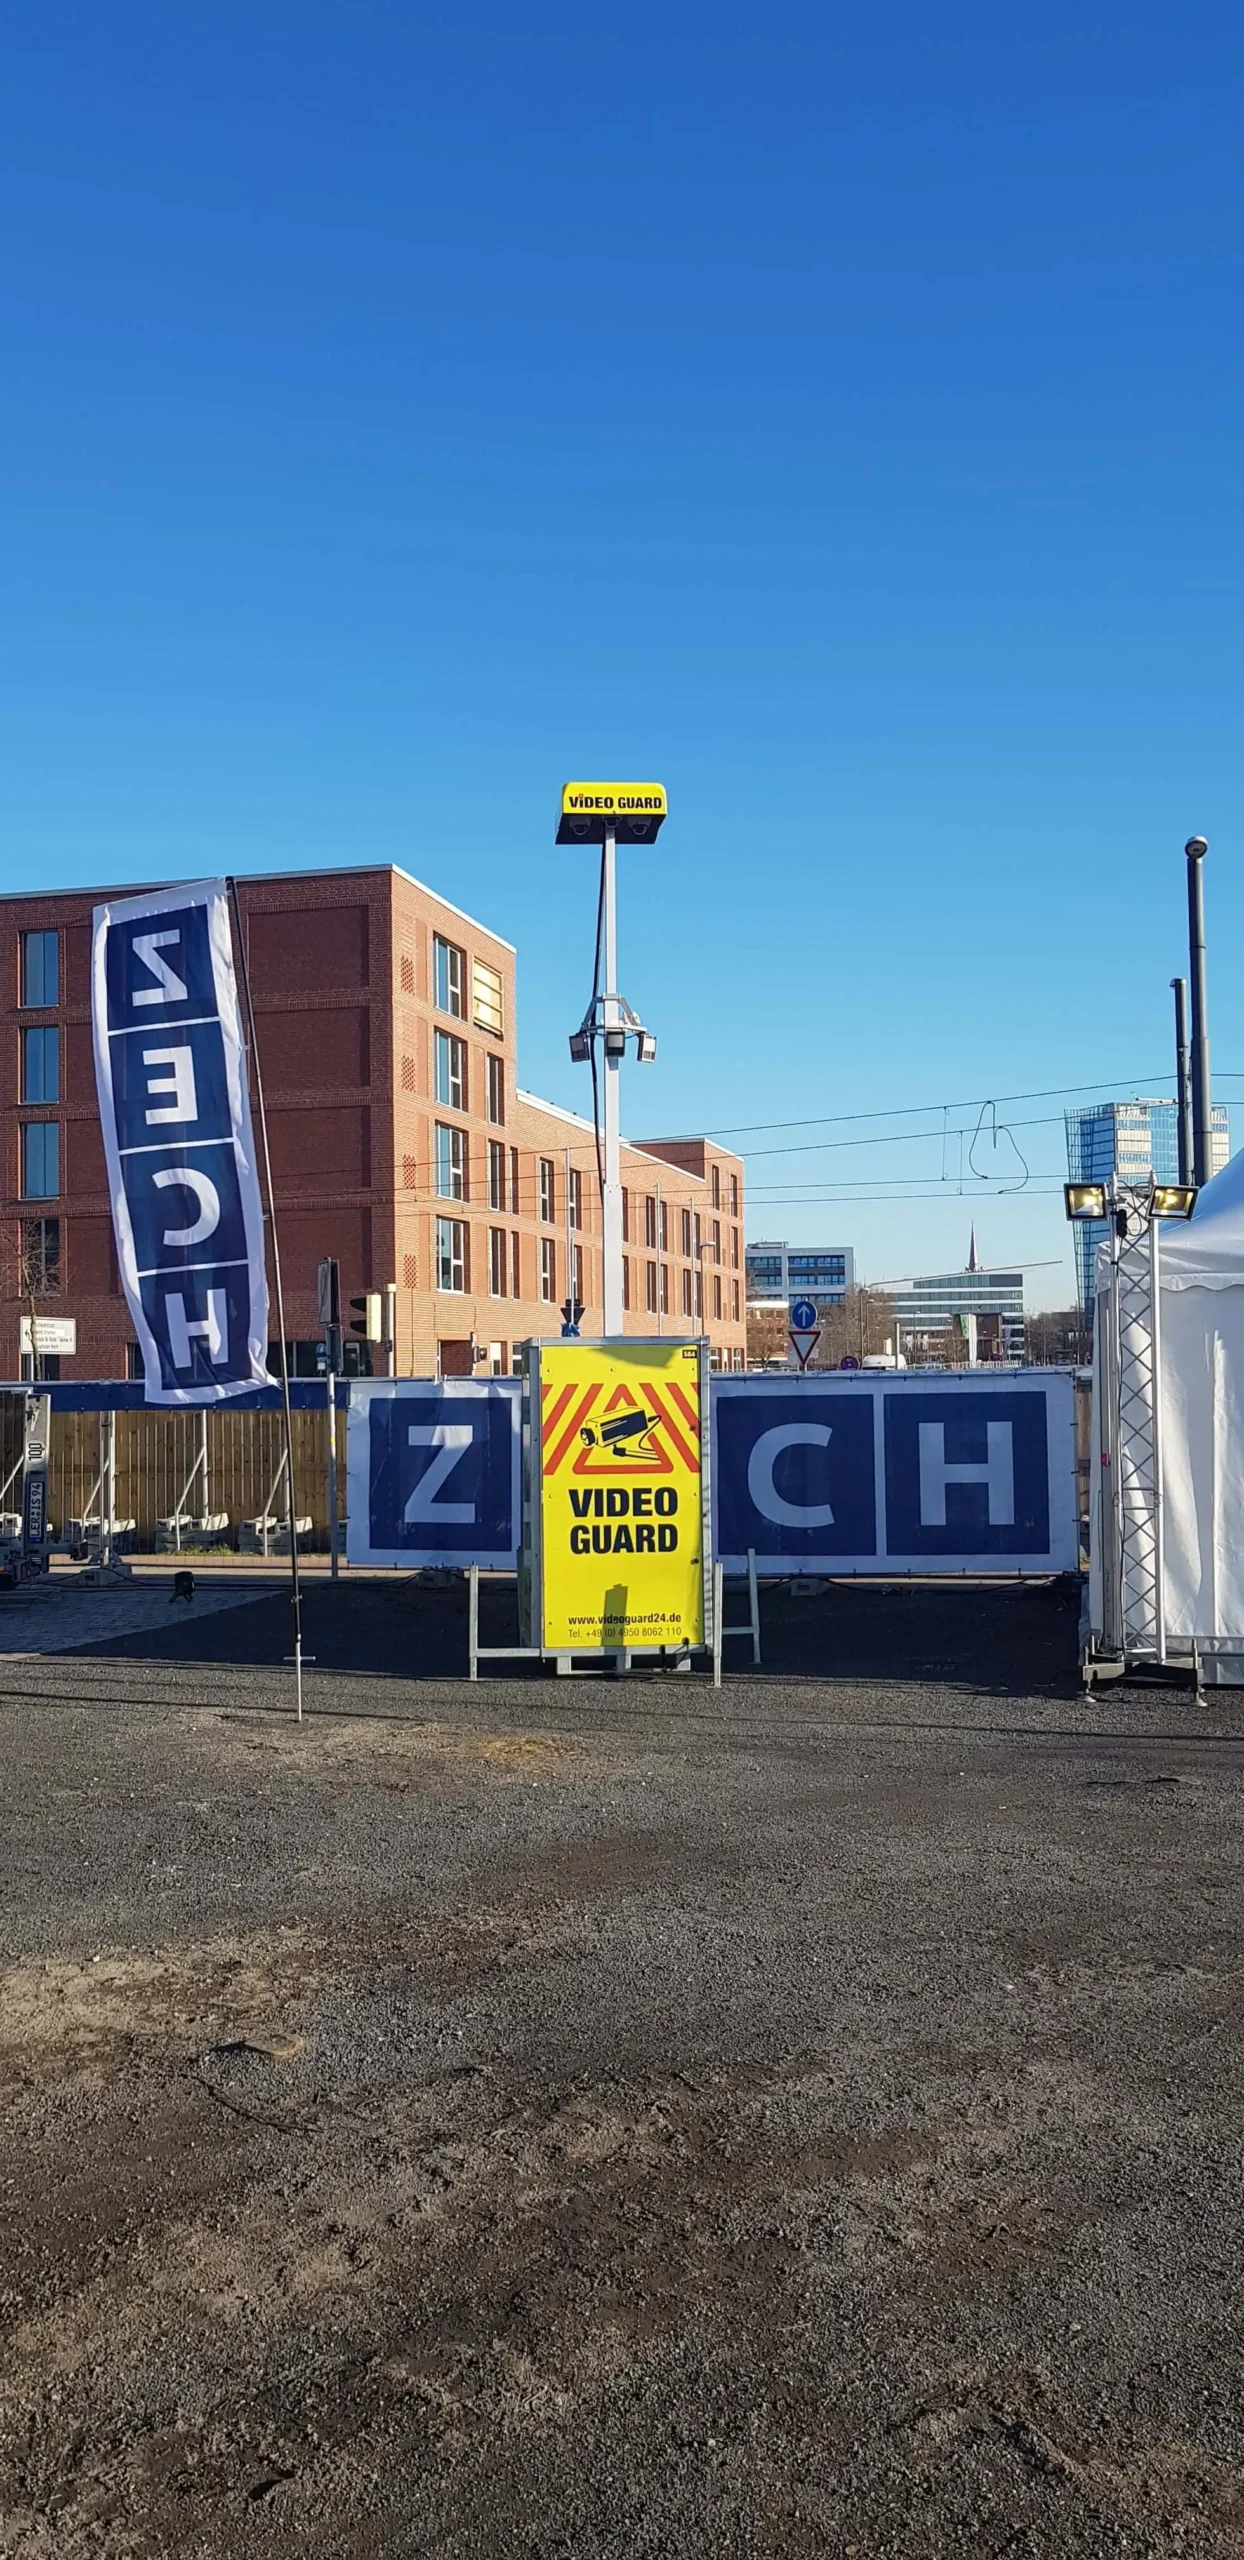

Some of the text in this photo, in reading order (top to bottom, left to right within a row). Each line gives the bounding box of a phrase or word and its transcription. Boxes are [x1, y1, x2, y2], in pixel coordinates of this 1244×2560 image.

[617, 796, 662, 809] GUARD
[28, 1442, 43, 1462] 100
[30, 1483, 41, 1496] 94
[568, 1487, 678, 1517] VIDEO
[30, 1518, 41, 1537] LER
[570, 1523, 678, 1555] GUARD
[568, 1612, 681, 1626] www.videoguard24.de
[568, 1626, 682, 1638] Tel. +49 (0) 4950 8062 110
